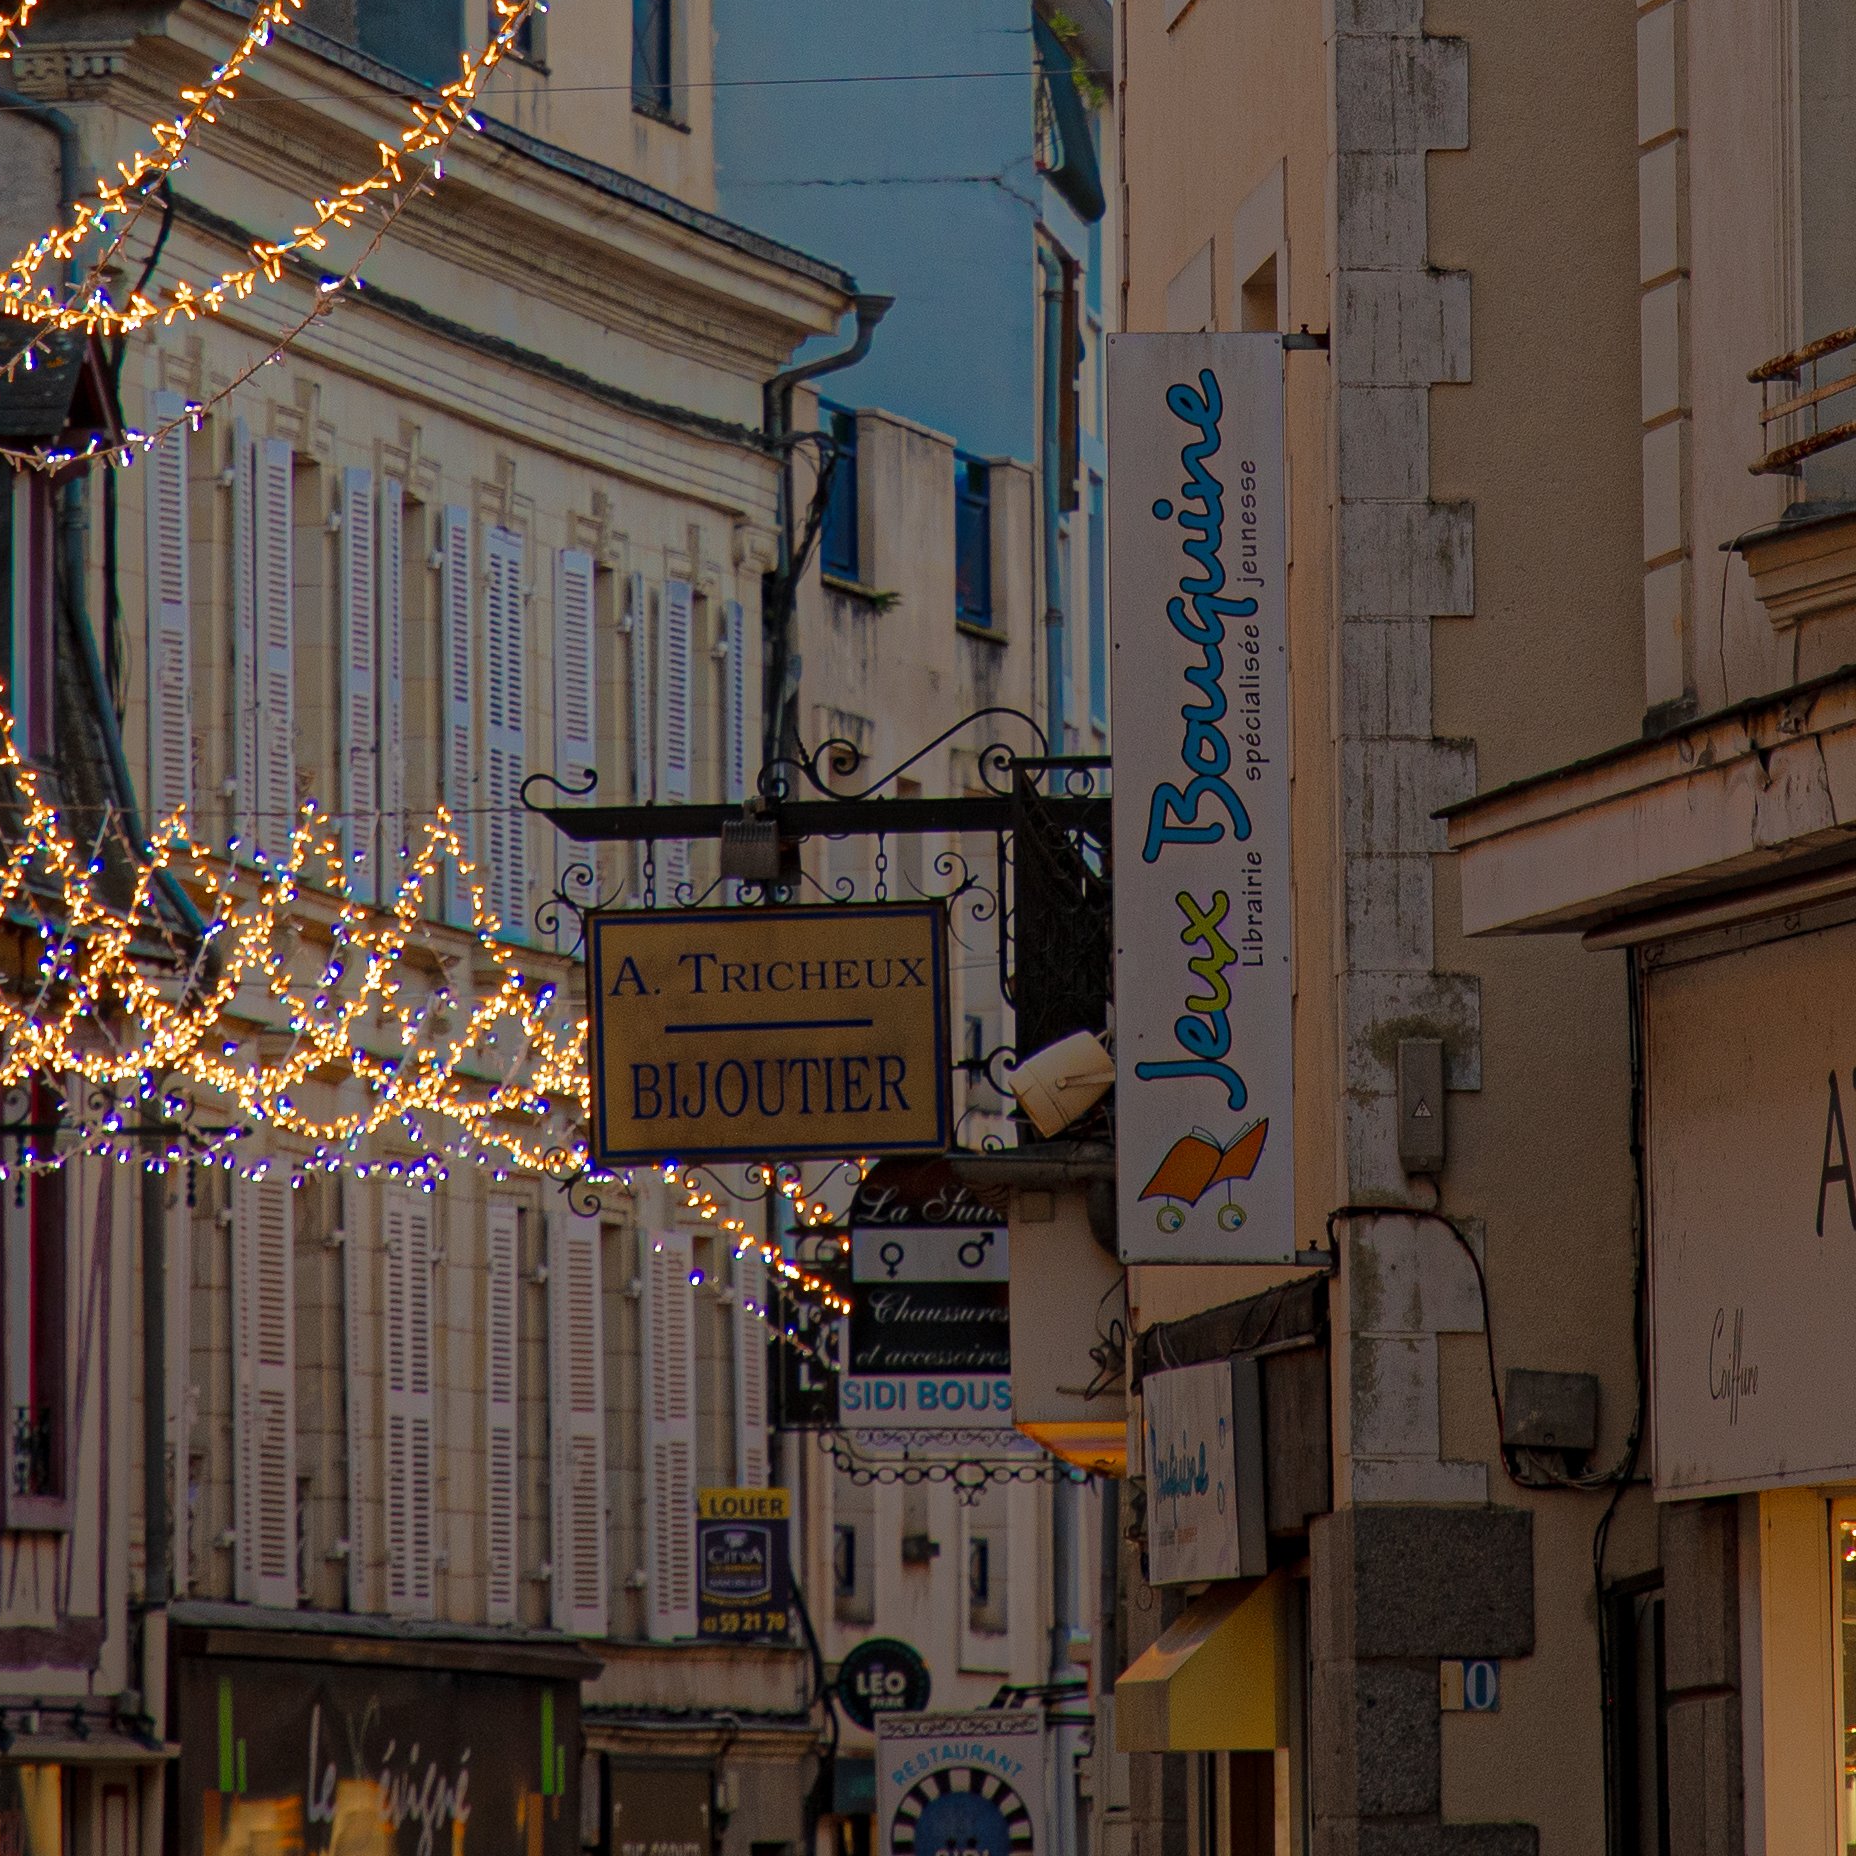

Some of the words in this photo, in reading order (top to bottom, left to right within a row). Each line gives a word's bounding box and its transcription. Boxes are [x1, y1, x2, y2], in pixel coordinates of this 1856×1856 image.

[1237, 459, 1268, 586] jeunesse
[1141, 368, 1257, 865] Bouquine
[1244, 624, 1264, 782] spécialisée
[1241, 850, 1266, 967] Librairie
[609, 955, 662, 998] A.
[1134, 889, 1247, 1112] Jeux
[630, 1055, 911, 1121] BIJOUTIER
[856, 1185, 911, 1224] La
[867, 1287, 1010, 1325] Chaussures
[843, 1380, 906, 1410] SIDI
[1709, 1307, 1759, 1426] Coiffure
[709, 1496, 784, 1516] LOUER
[891, 1743, 1023, 1786] RESTAURANT
